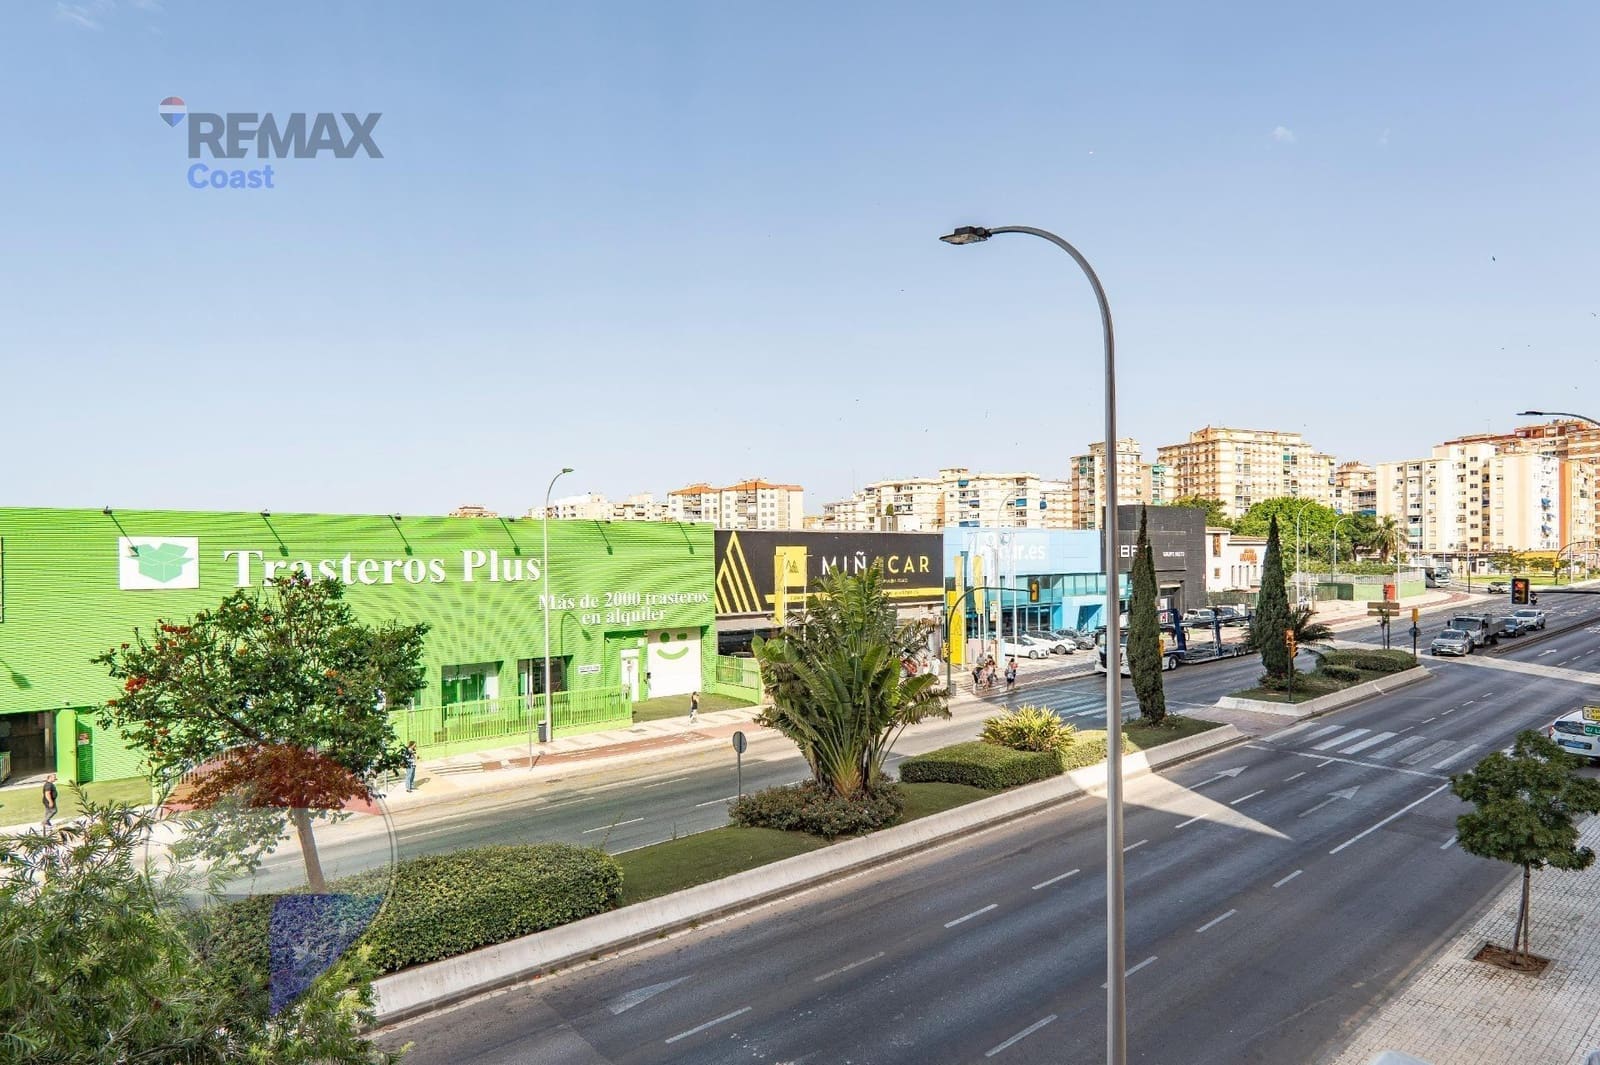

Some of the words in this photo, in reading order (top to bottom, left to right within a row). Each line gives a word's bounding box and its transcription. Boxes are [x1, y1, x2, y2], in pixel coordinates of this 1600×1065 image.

[223, 550, 446, 588] Trasteros
[461, 549, 542, 582] Plus
[539, 594, 575, 611] Más
[580, 594, 600, 609] de
[604, 591, 641, 608] 2000
[645, 589, 709, 606] trasteros
[582, 612, 601, 626] en
[605, 607, 667, 627] alquiler
